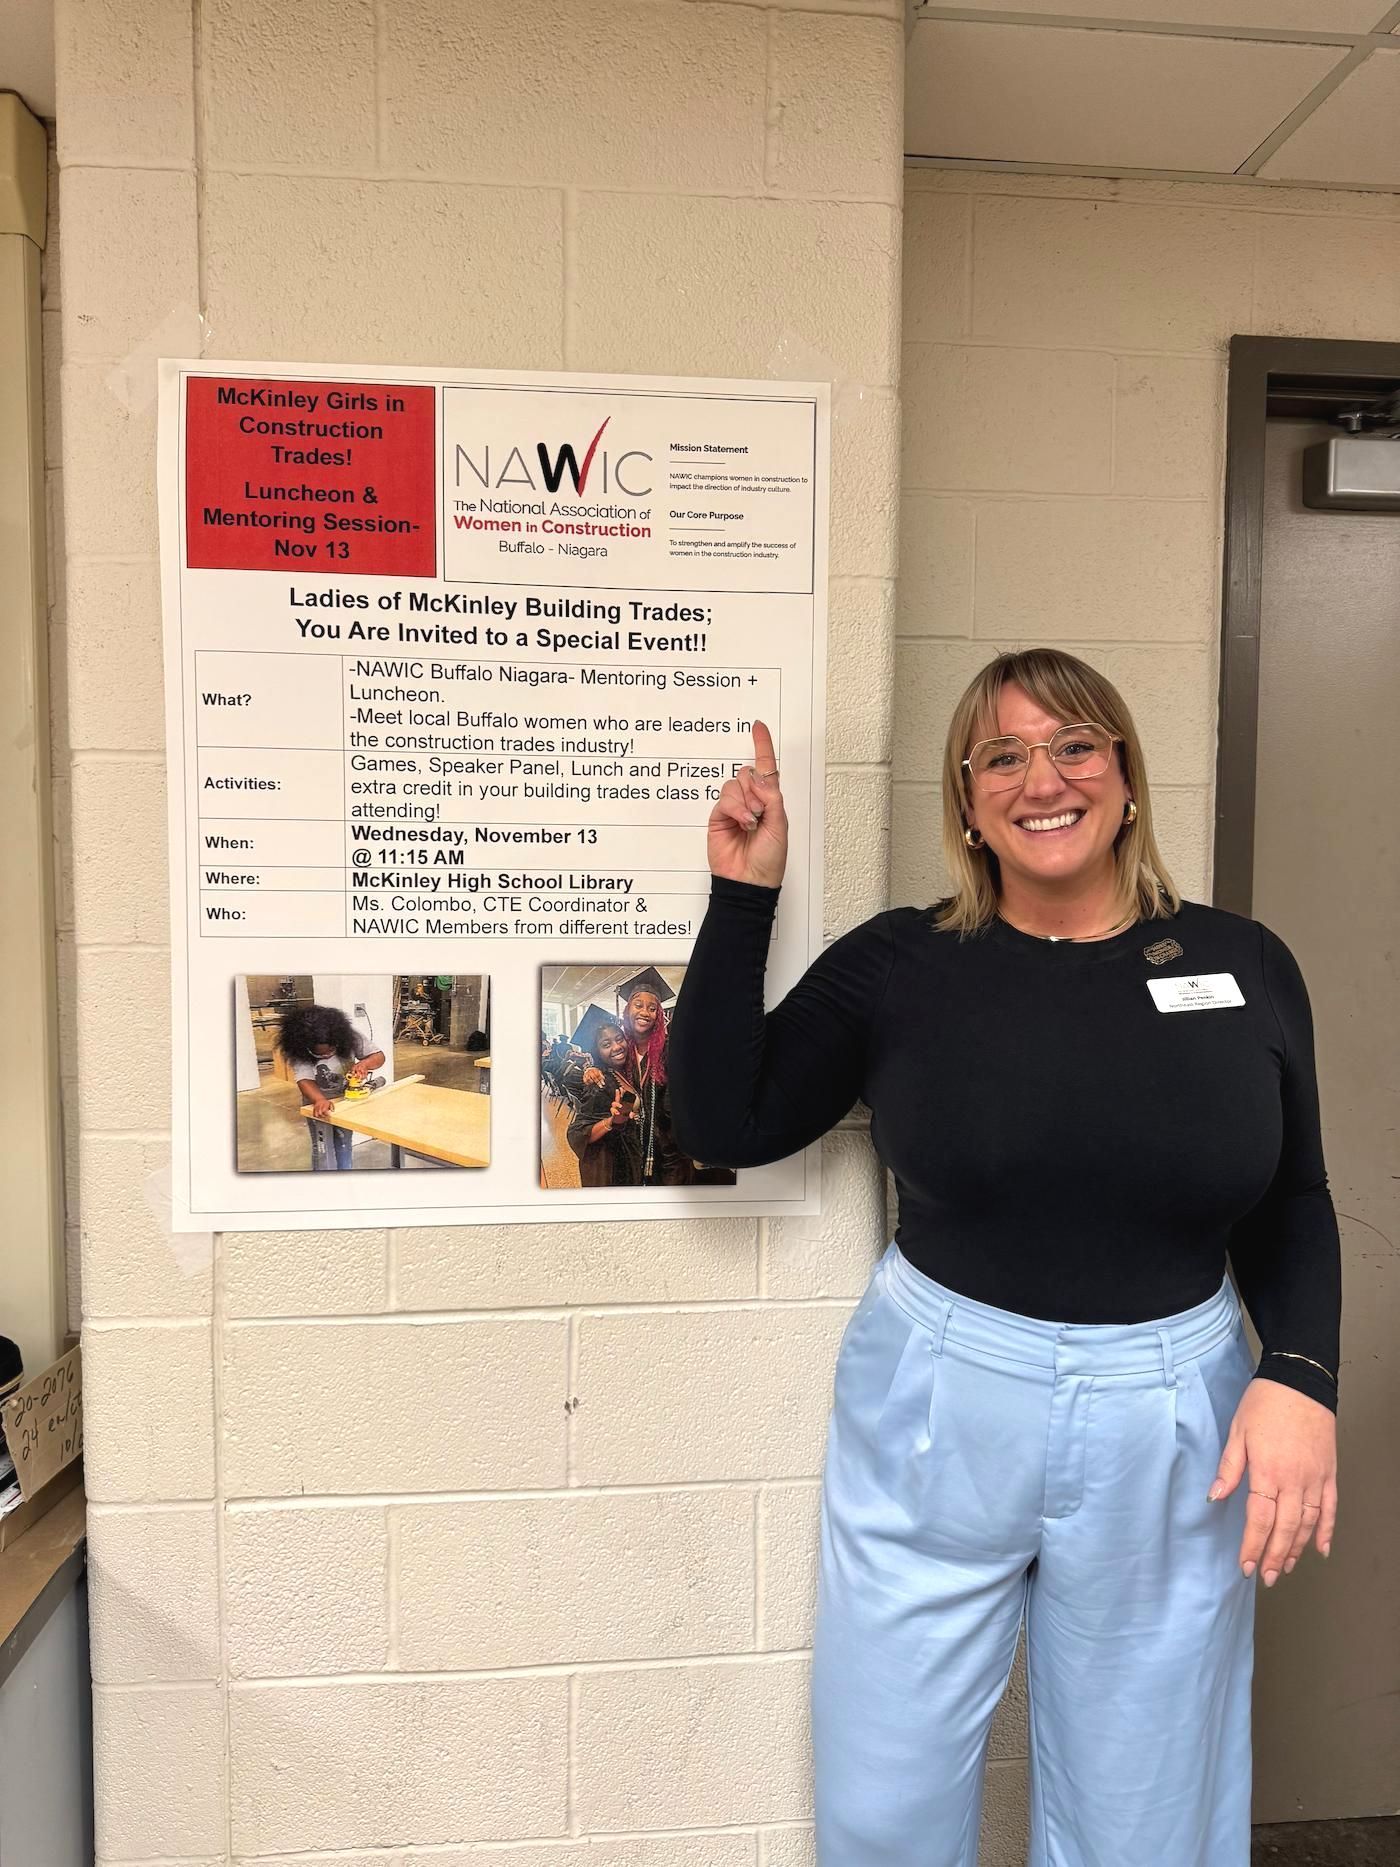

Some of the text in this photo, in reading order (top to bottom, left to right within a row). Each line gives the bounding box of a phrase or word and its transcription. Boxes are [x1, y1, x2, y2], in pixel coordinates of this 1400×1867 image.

[217, 387, 405, 413] McKinley Girls in
[239, 416, 383, 439] Construction
[271, 446, 352, 465] Trades!
[455, 416, 653, 497] NAWIC
[670, 444, 748, 453] Mission Statement
[244, 482, 378, 504] Luncheon &
[741, 485, 766, 493] industry
[454, 499, 651, 520] The National Association of
[687, 511, 707, 519] Core
[709, 512, 744, 521] Purpose
[203, 508, 420, 534] Mentoring Session-
[454, 515, 651, 538] Women in Construction
[274, 539, 350, 558] Nov 13
[499, 540, 544, 554] Buffalo
[558, 543, 608, 558] Niagara
[727, 541, 750, 549] amplify
[290, 588, 712, 625] Ladies of McKinley Building Trades;
[296, 619, 707, 652] You Are Invited to a Special Event!!
[349, 660, 758, 689] -NAWIC Buffalo Niagara- Mentoring Session +
[203, 693, 252, 707] What?
[350, 684, 445, 702] Luncheon.
[350, 709, 751, 733] -Meet local Buffalo women who are leaders in
[350, 732, 634, 757] the construction trades industry!
[351, 755, 422, 774] Games,
[429, 757, 506, 776] Speaker
[510, 760, 565, 777] Panel,
[571, 762, 623, 777] Lunch
[629, 762, 661, 777] and
[668, 764, 724, 778] Prizes!
[204, 777, 281, 790] Activities:
[351, 780, 720, 802] extra credit in your building trades class fo
[351, 803, 440, 822] attending!
[206, 837, 254, 849] When:
[352, 825, 598, 845] Wednesday, November 13
[352, 849, 464, 868] @ 11:15 AM
[206, 872, 260, 885] Where:
[352, 872, 633, 893] McKinley High School Library
[207, 908, 246, 920] Who:
[353, 896, 647, 914] Ms. Colombo, CTE Coordinator &
[353, 919, 691, 935] NAWIC Members from different trades!
[23, 1419, 38, 1461] 24
